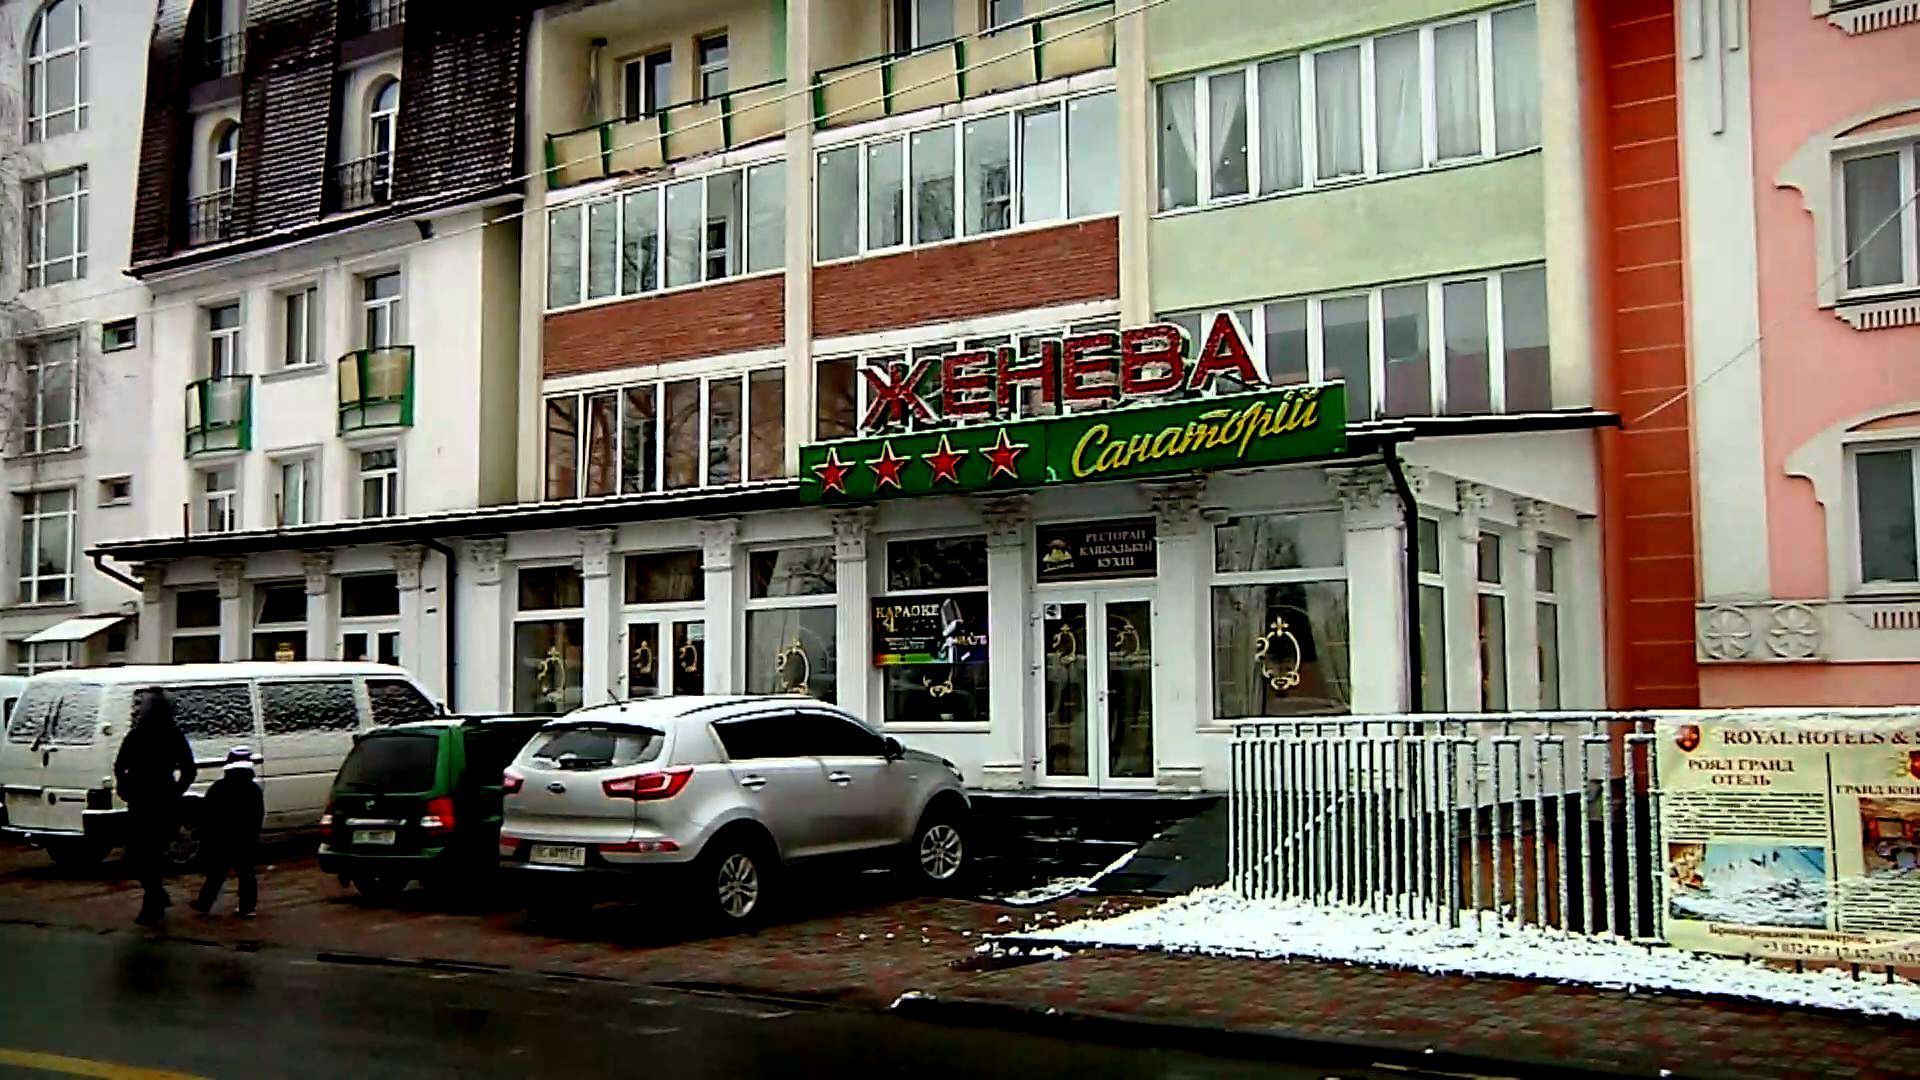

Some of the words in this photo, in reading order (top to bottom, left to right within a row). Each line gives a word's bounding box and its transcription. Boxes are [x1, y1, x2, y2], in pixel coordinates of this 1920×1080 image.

[859, 311, 1266, 430] ЖЕНЕВА
[1072, 387, 1318, 477] Санаторій
[1086, 530, 1146, 542] РЕСТОРАН
[876, 604, 940, 618] КАРАОКЕ
[1724, 731, 1792, 744] ROYAL
[1799, 731, 1885, 744] HOTELS
[1891, 730, 1909, 744] &
[1688, 759, 1732, 770] РОЯЛ
[1739, 759, 1794, 772] ГРАНД
[1711, 774, 1771, 786] ОТЕЛЬ
